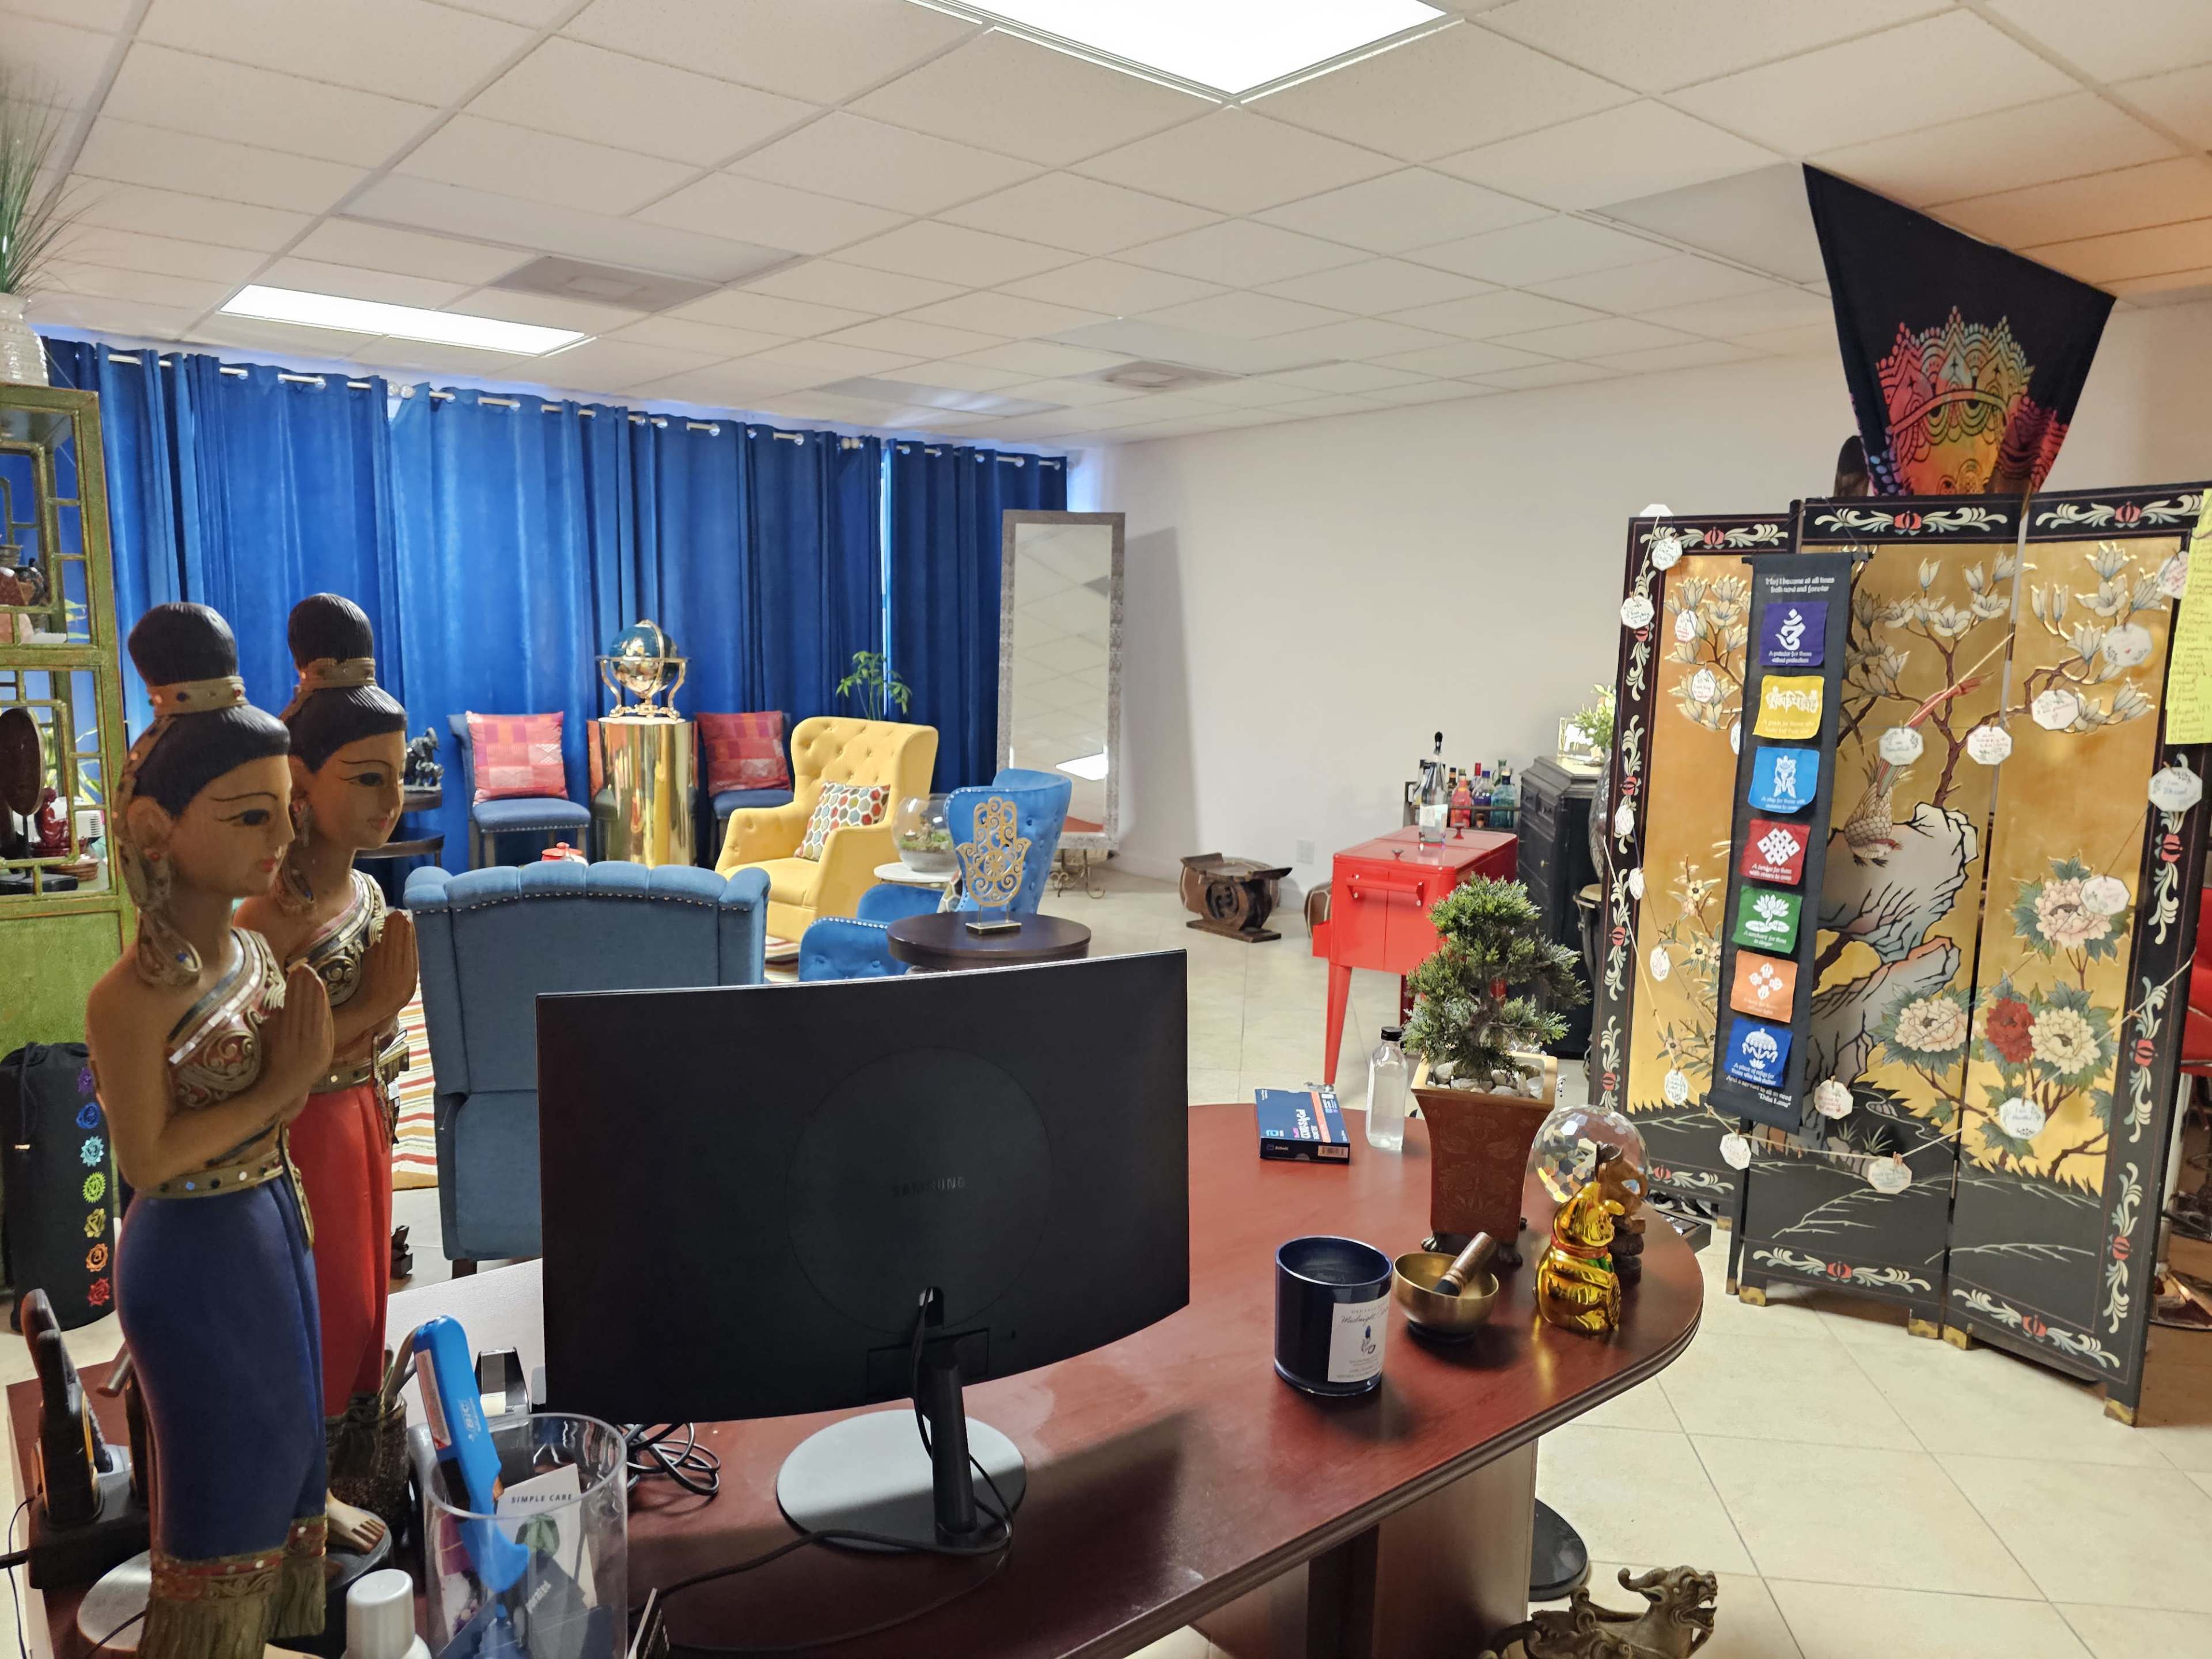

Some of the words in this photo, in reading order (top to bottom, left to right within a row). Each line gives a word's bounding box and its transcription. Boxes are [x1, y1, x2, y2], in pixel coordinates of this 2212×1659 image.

[892, 1176, 965, 1196] SAMSUNG
[510, 1494, 546, 1504] SIMPLE
[549, 1493, 573, 1502] CARE
